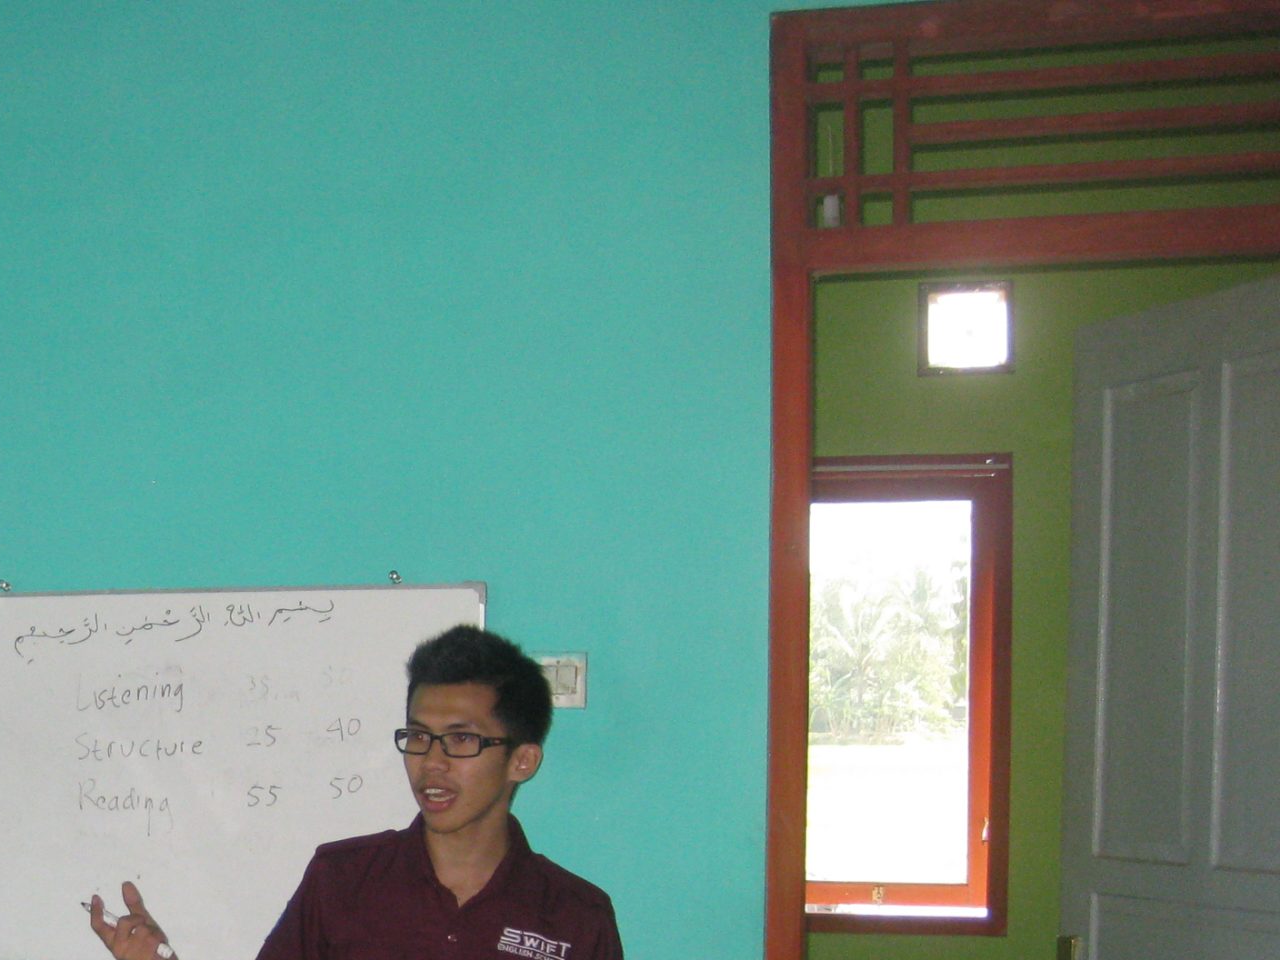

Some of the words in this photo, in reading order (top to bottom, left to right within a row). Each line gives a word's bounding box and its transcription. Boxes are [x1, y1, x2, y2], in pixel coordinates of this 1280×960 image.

[75, 671, 184, 713] Listening
[74, 732, 204, 761] Structure
[325, 717, 362, 742] 40
[78, 778, 174, 836] Reading
[246, 785, 283, 808] 55
[329, 774, 364, 800] 50
[500, 927, 572, 958] SWIFT
